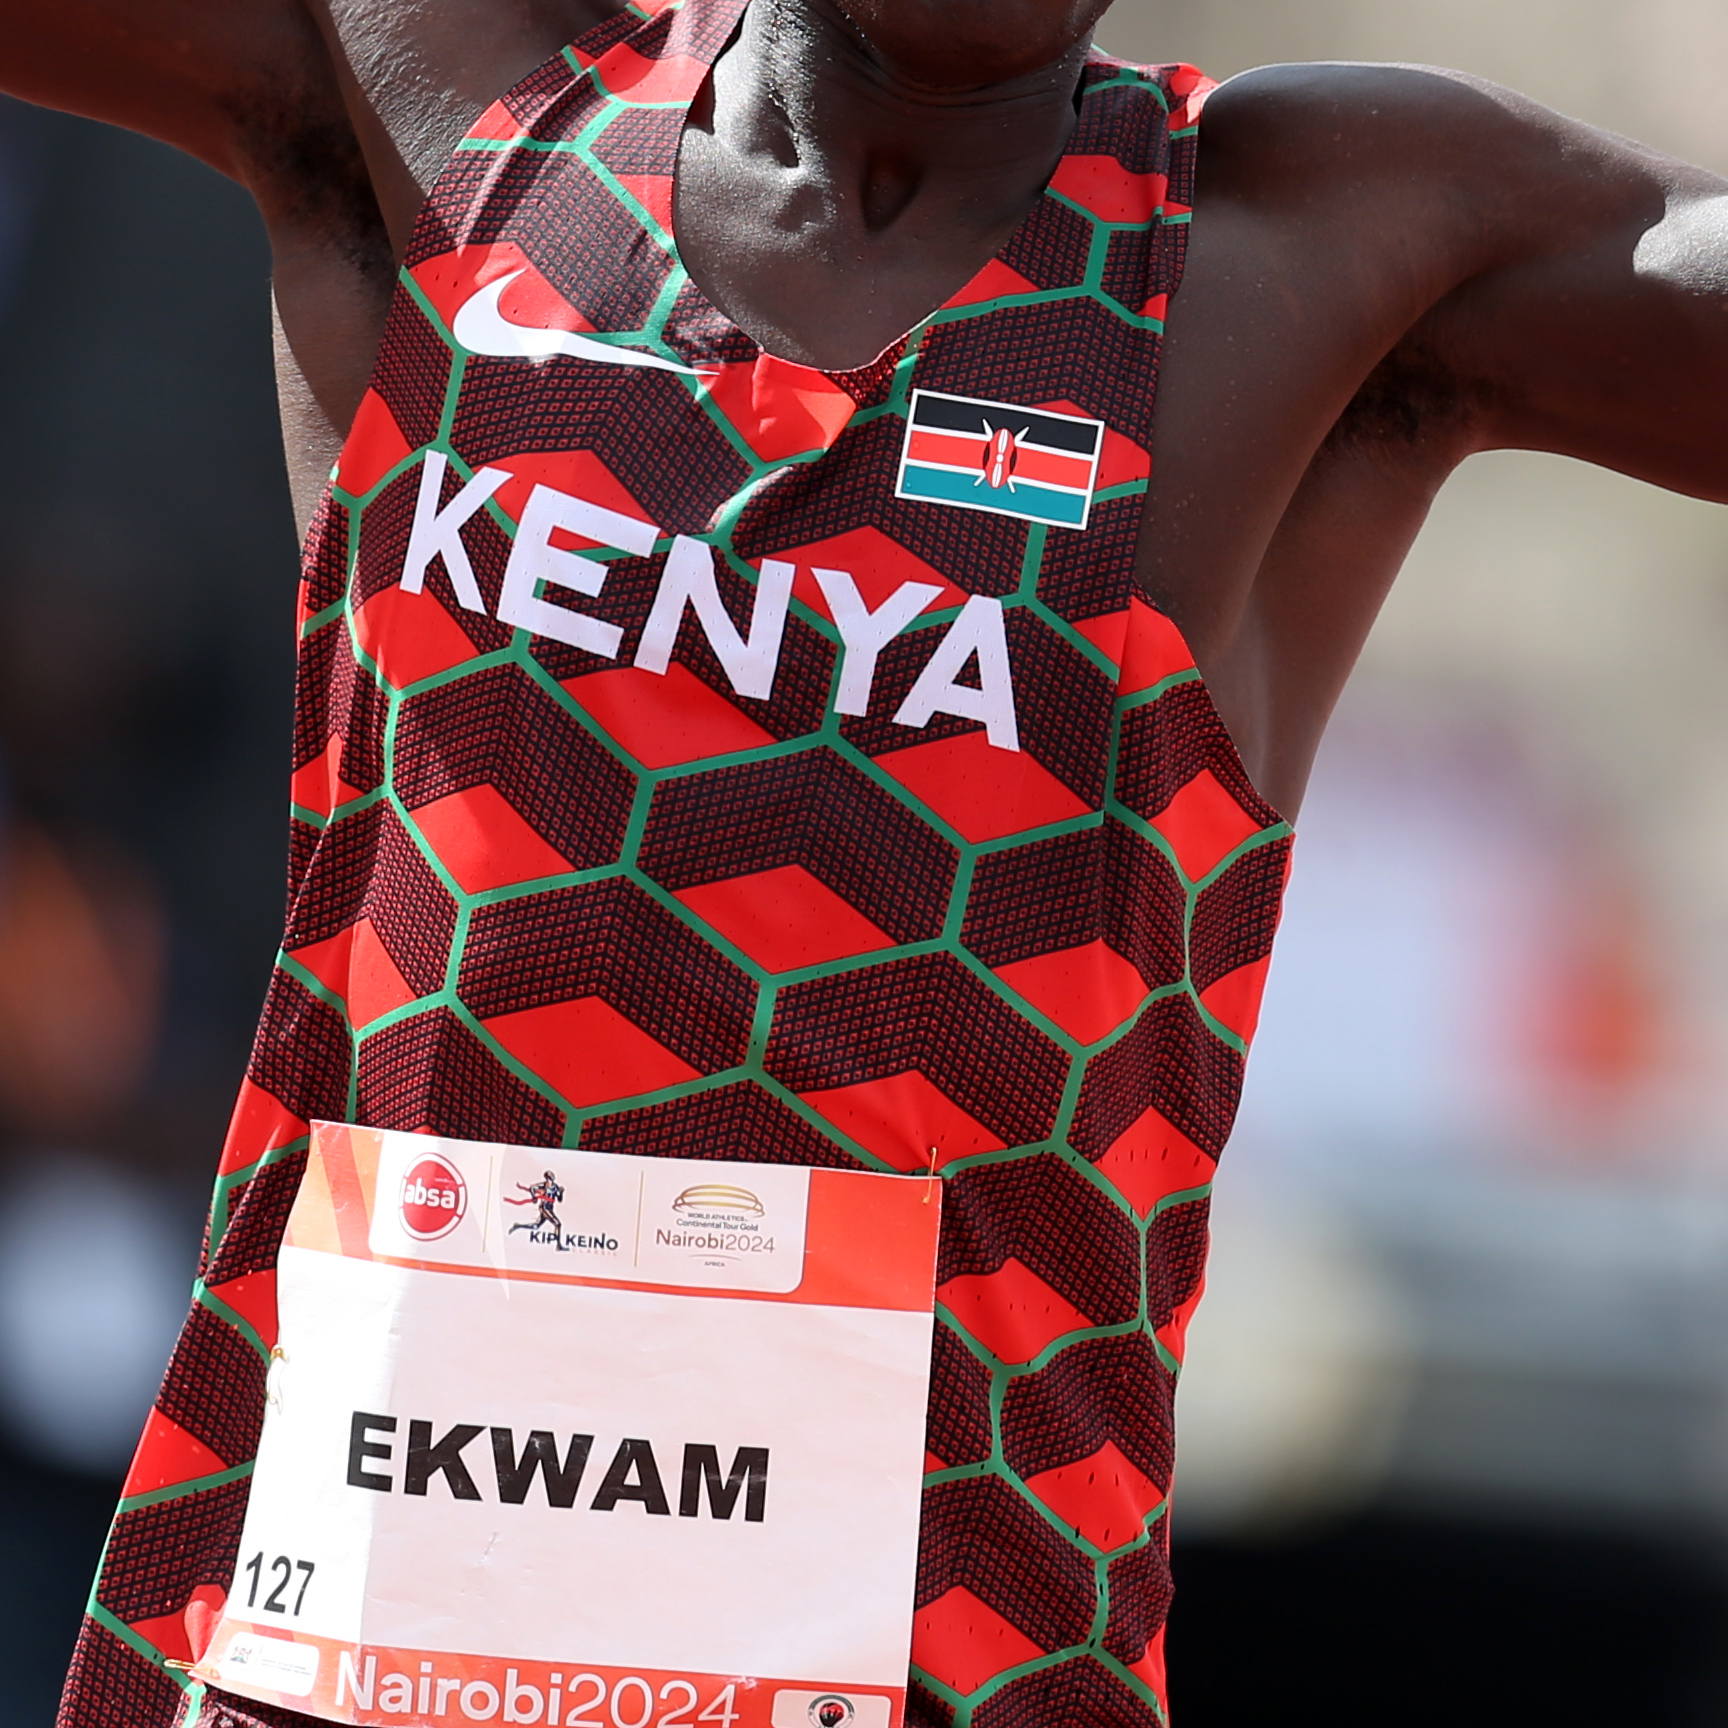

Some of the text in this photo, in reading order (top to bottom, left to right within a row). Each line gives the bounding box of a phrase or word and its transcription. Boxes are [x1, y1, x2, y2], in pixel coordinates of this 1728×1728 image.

[400, 449, 1021, 753] KENYA
[404, 1177, 456, 1209] absa
[529, 1231, 557, 1244] KIP
[656, 1228, 776, 1253] Nairobi2024
[676, 1218, 759, 1232] Continental Tour Gold
[345, 1410, 770, 1523] EKWAM
[246, 1551, 315, 1616] 127
[334, 1651, 740, 1728] Nairobi2024
